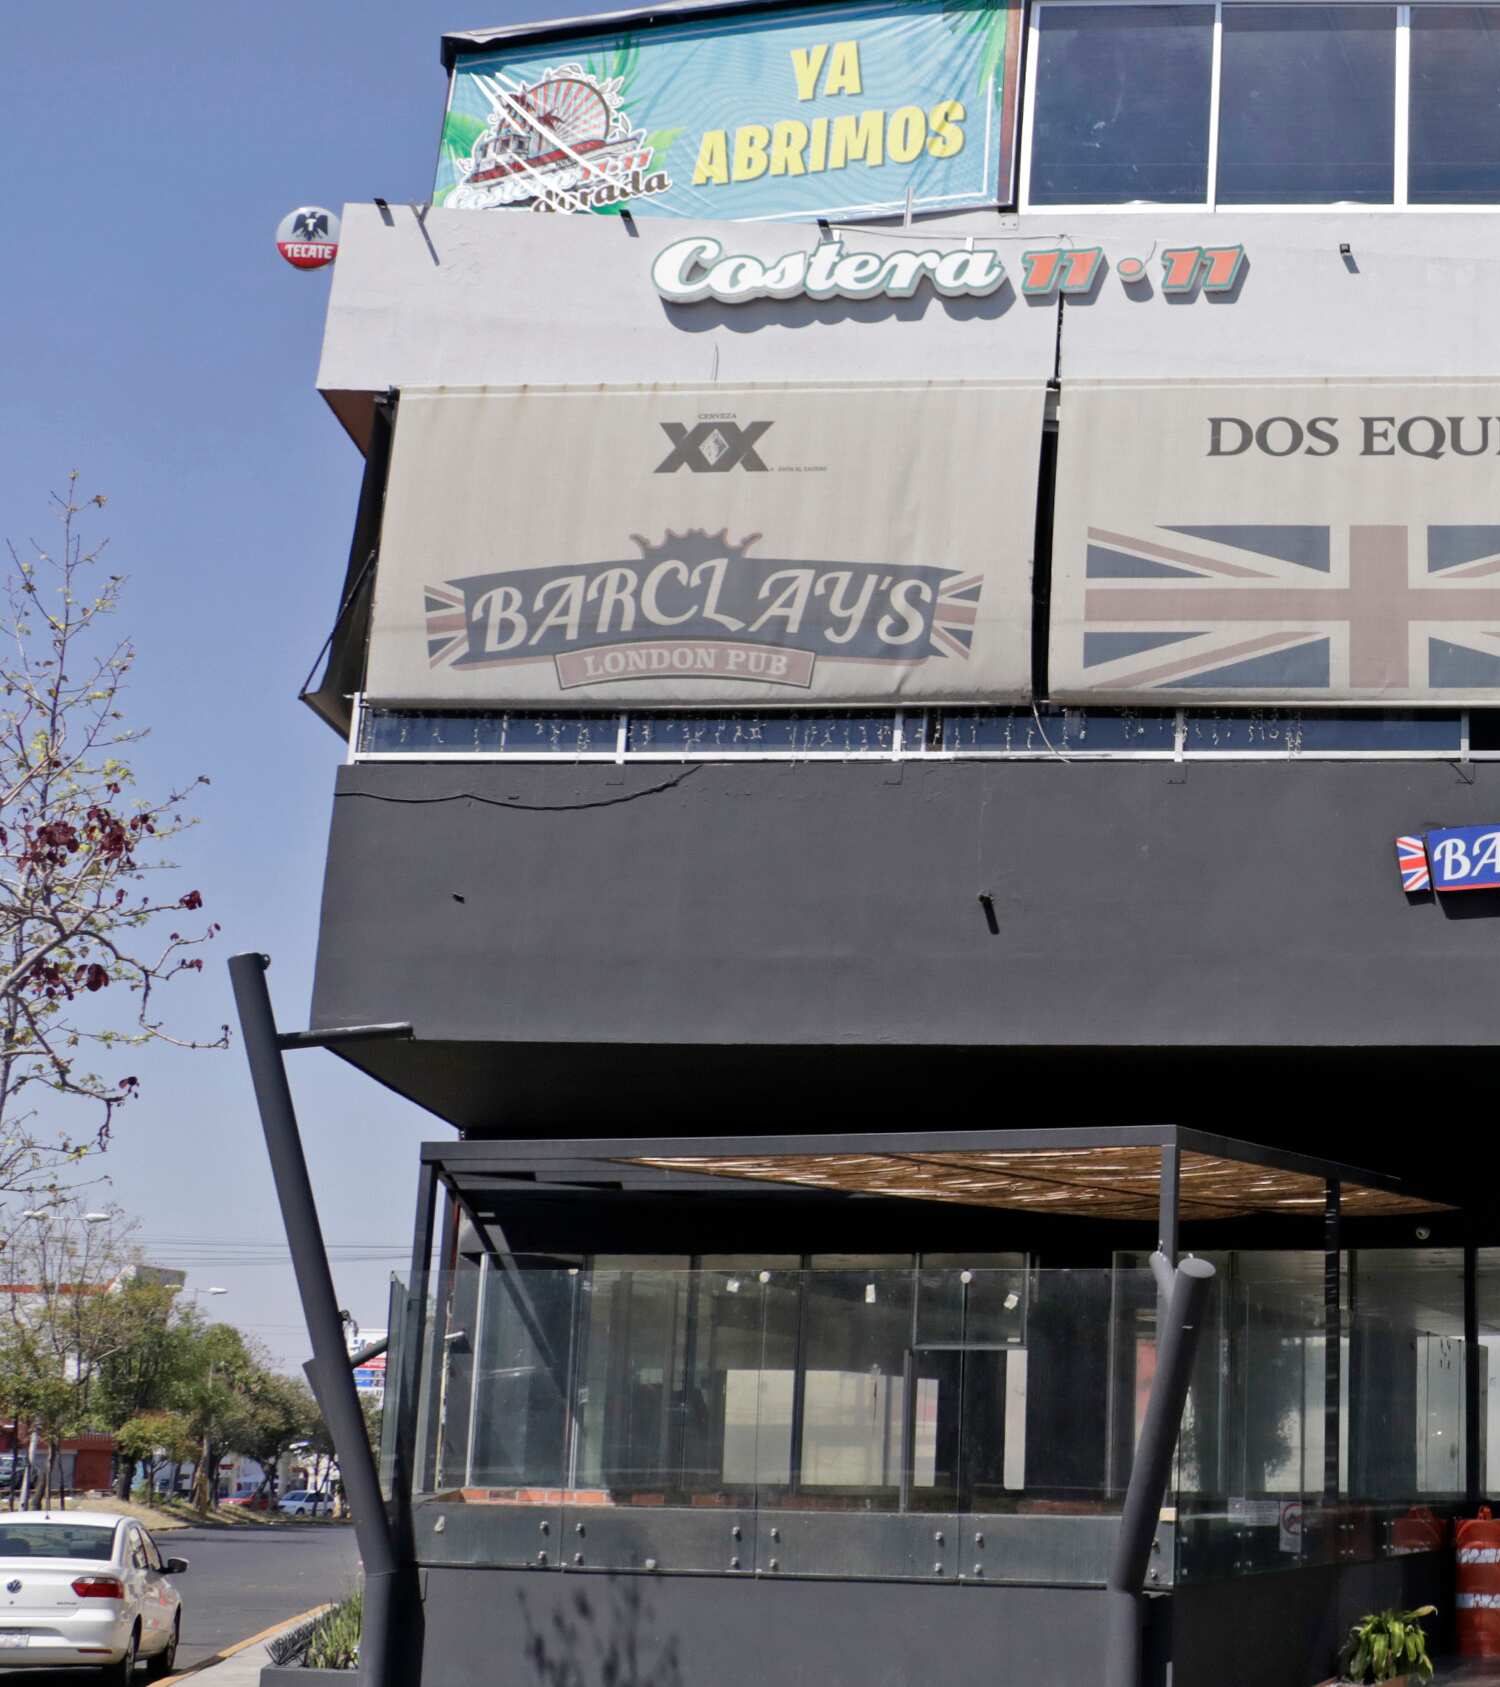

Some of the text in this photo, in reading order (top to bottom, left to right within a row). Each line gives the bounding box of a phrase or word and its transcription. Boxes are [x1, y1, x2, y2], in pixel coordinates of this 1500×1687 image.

[790, 40, 863, 102] YA
[691, 99, 967, 186] ABRIMOS
[284, 243, 334, 259] TECATE
[652, 238, 1002, 297] Costera
[1206, 416, 1339, 457] DOS
[472, 557, 932, 652] BARCLAY'S
[583, 648, 788, 677] LONDON PUB
